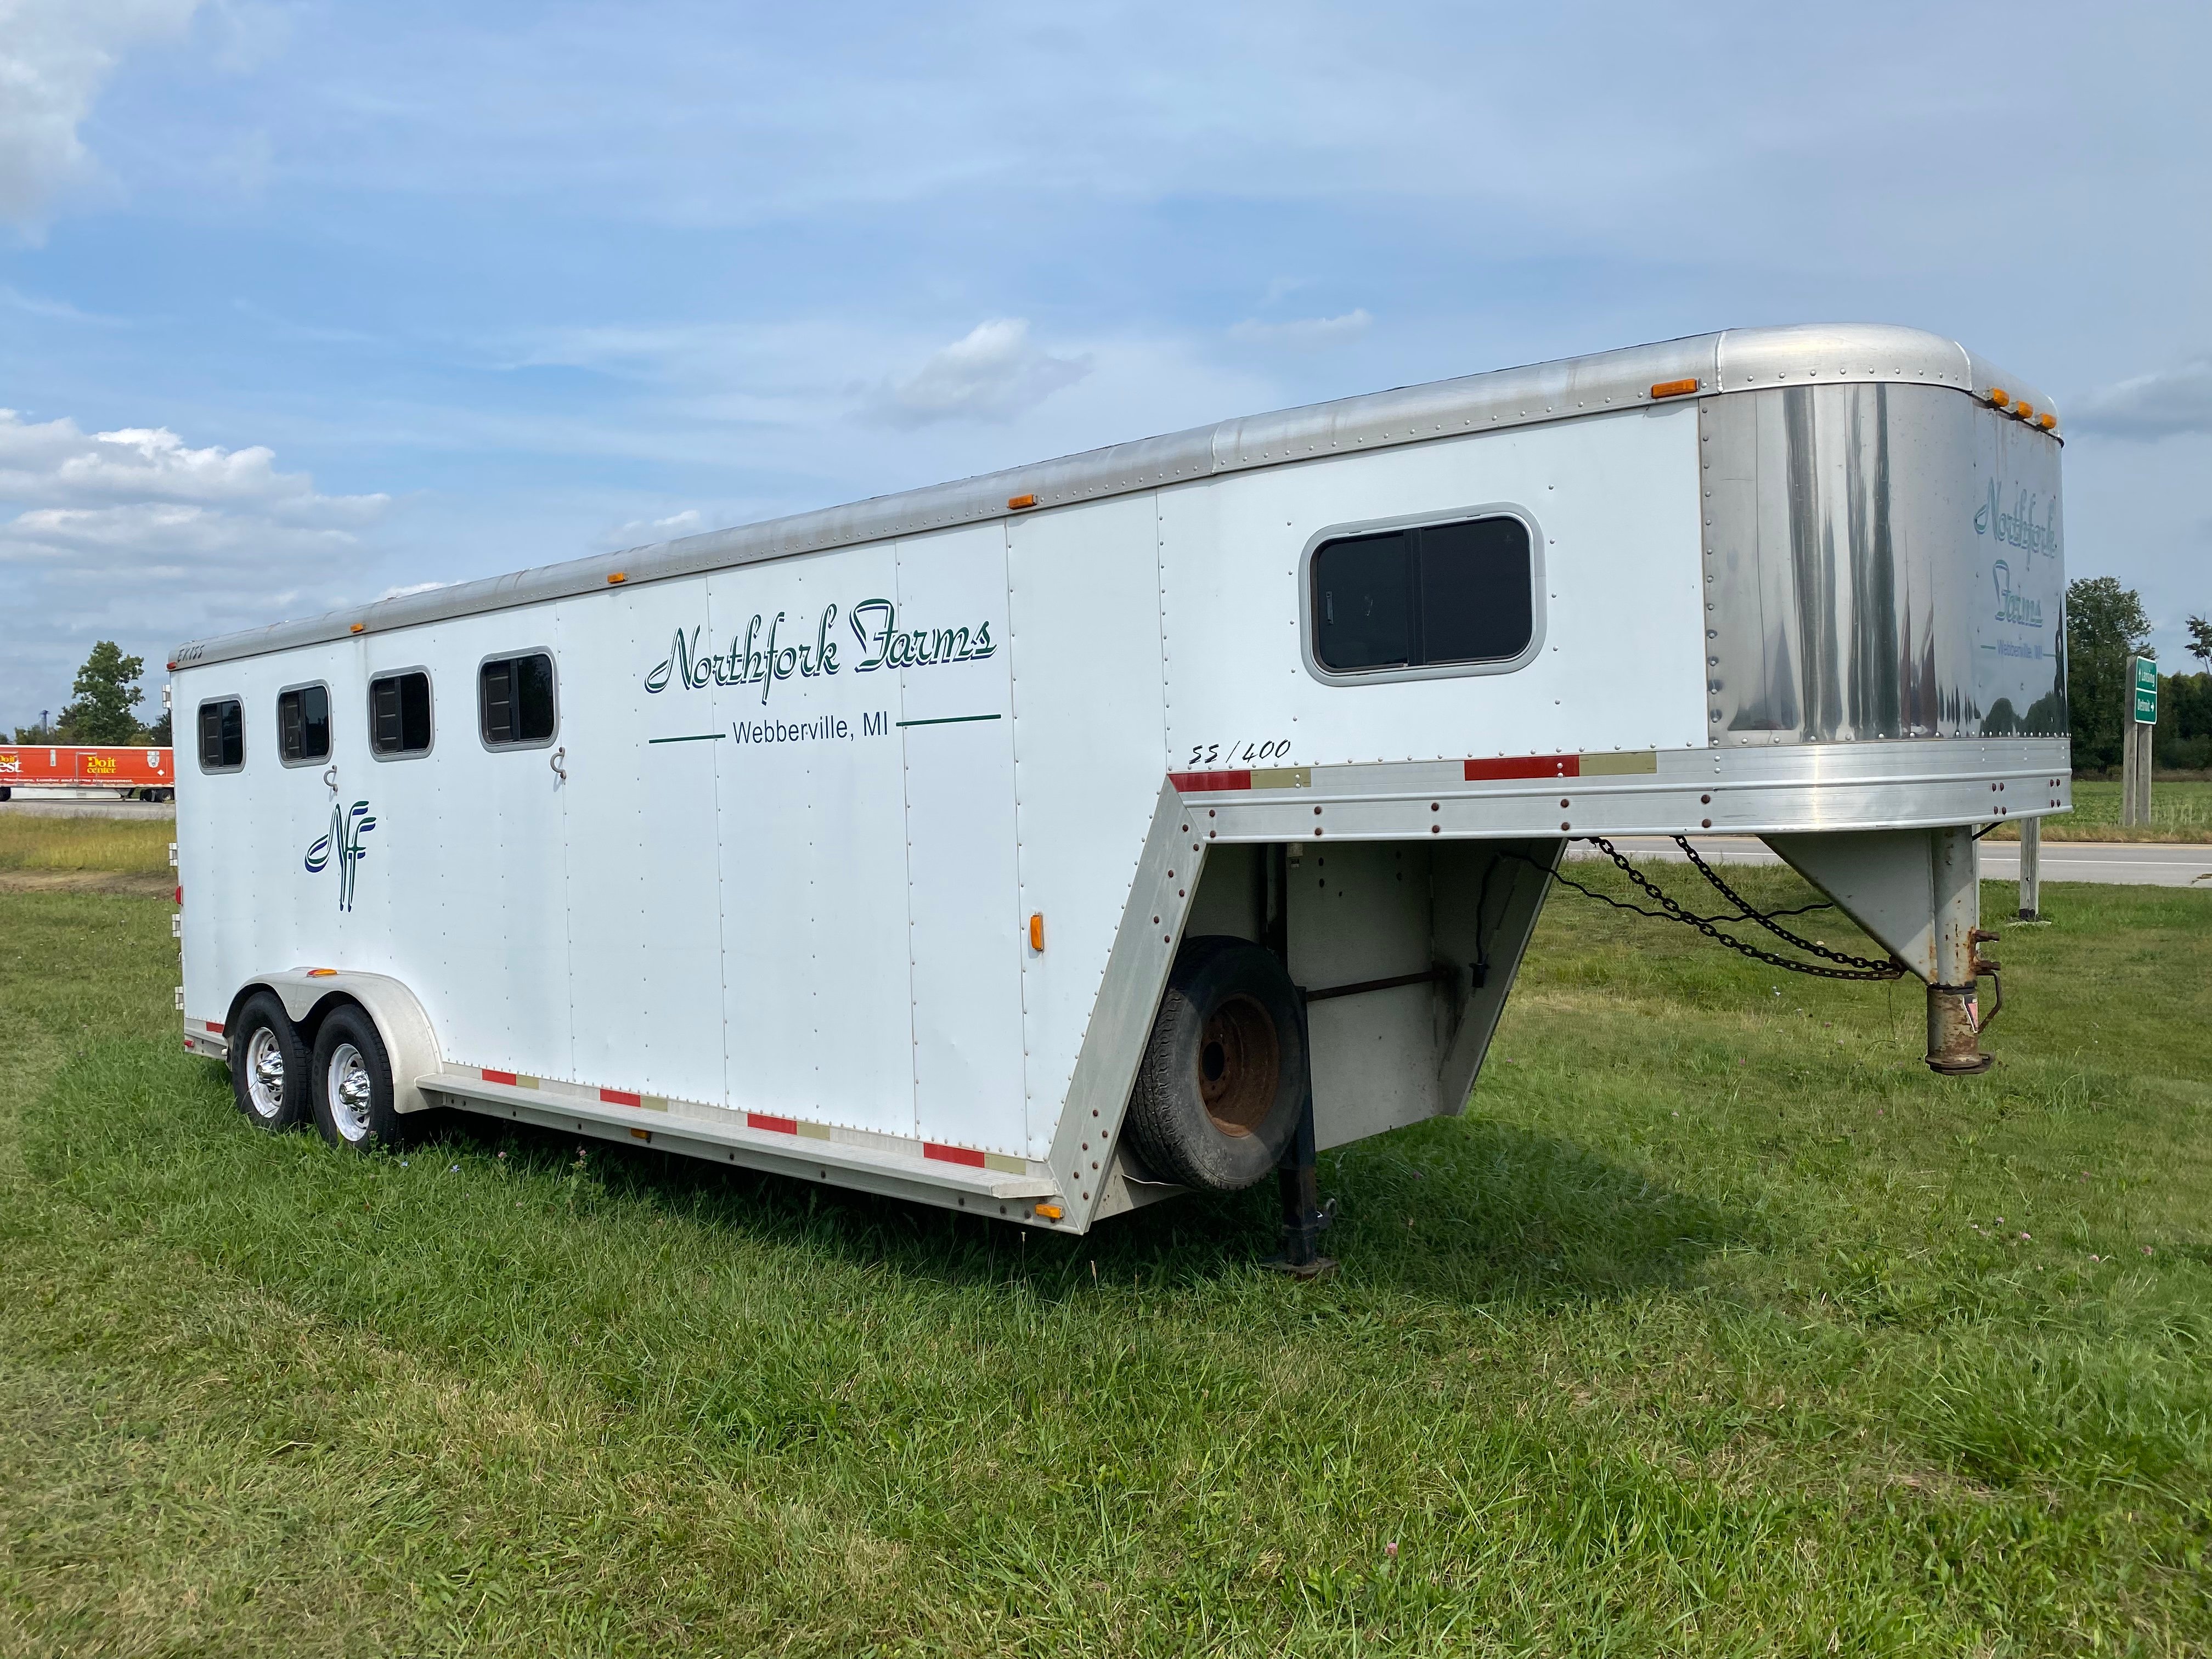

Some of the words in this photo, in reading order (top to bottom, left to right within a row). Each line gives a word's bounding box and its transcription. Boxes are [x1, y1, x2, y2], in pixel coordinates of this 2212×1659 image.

[1973, 476, 2056, 571] Northfork
[1993, 558, 2044, 628] Farms
[644, 602, 840, 706] Northfork
[849, 598, 997, 673] Farms
[733, 715, 855, 744] Webberville,
[863, 710, 888, 736] MI
